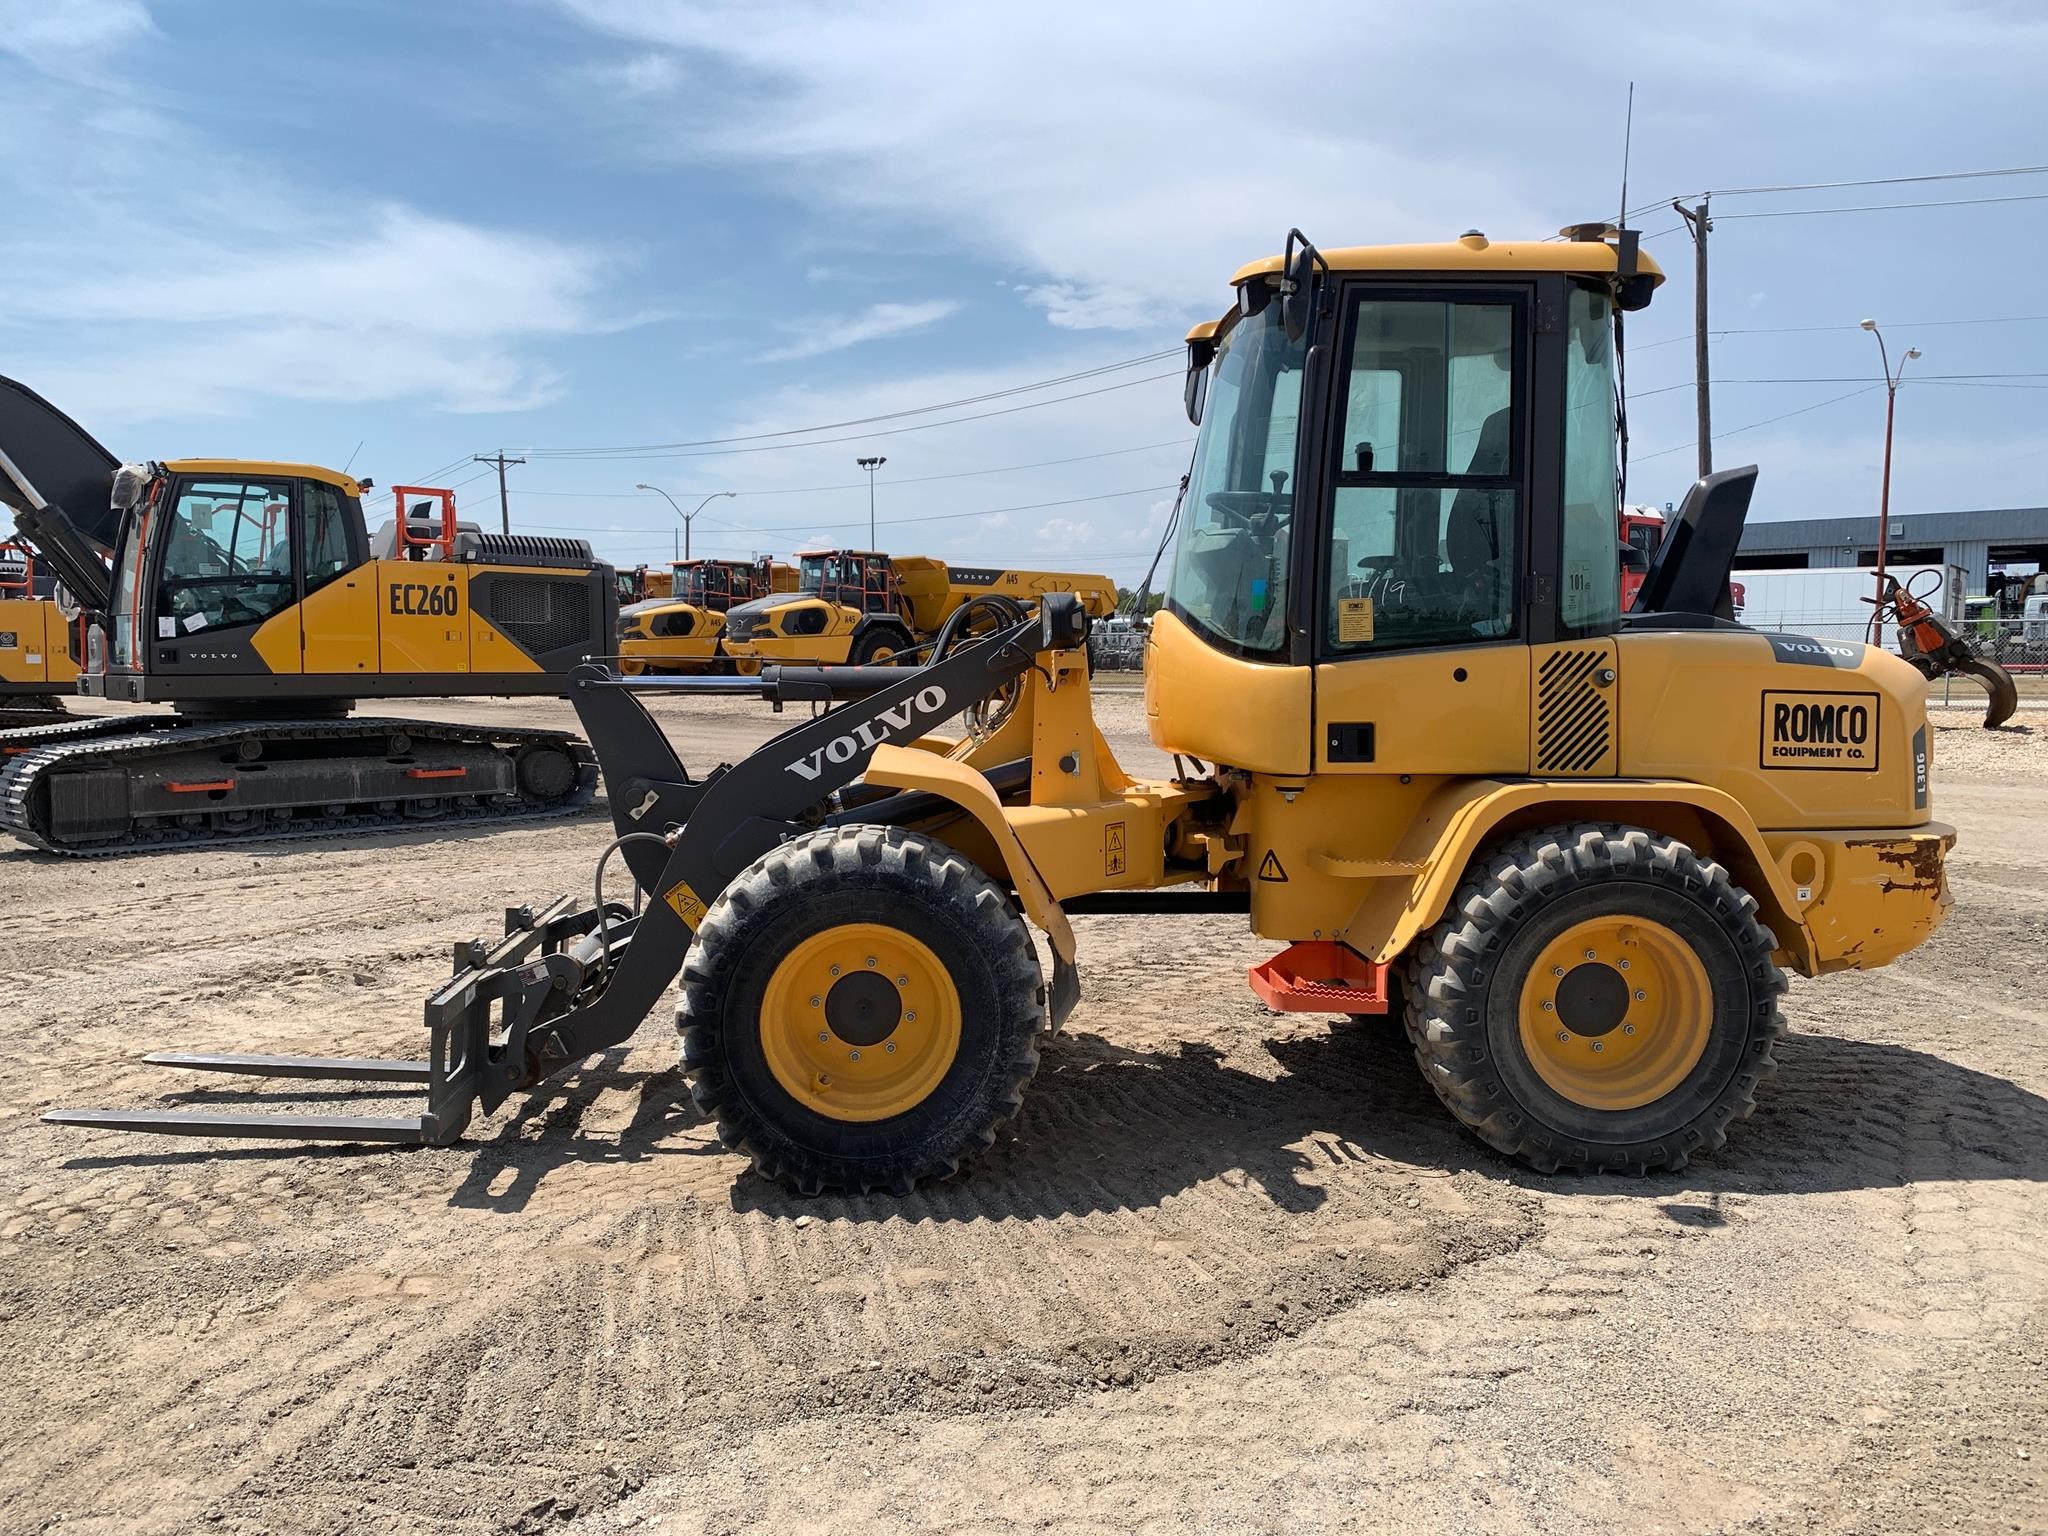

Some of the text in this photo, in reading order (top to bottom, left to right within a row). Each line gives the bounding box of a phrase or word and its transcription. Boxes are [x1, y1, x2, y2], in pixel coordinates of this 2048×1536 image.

[1006, 573, 1018, 585] A45
[390, 583, 458, 616] EC260
[1778, 642, 1854, 657] VOLVO
[784, 685, 947, 781] VOLVO
[1773, 703, 1868, 745] ROMCO
[1772, 746, 1865, 759] EQUIPMENT CO.
[1916, 752, 1926, 793] L30G
